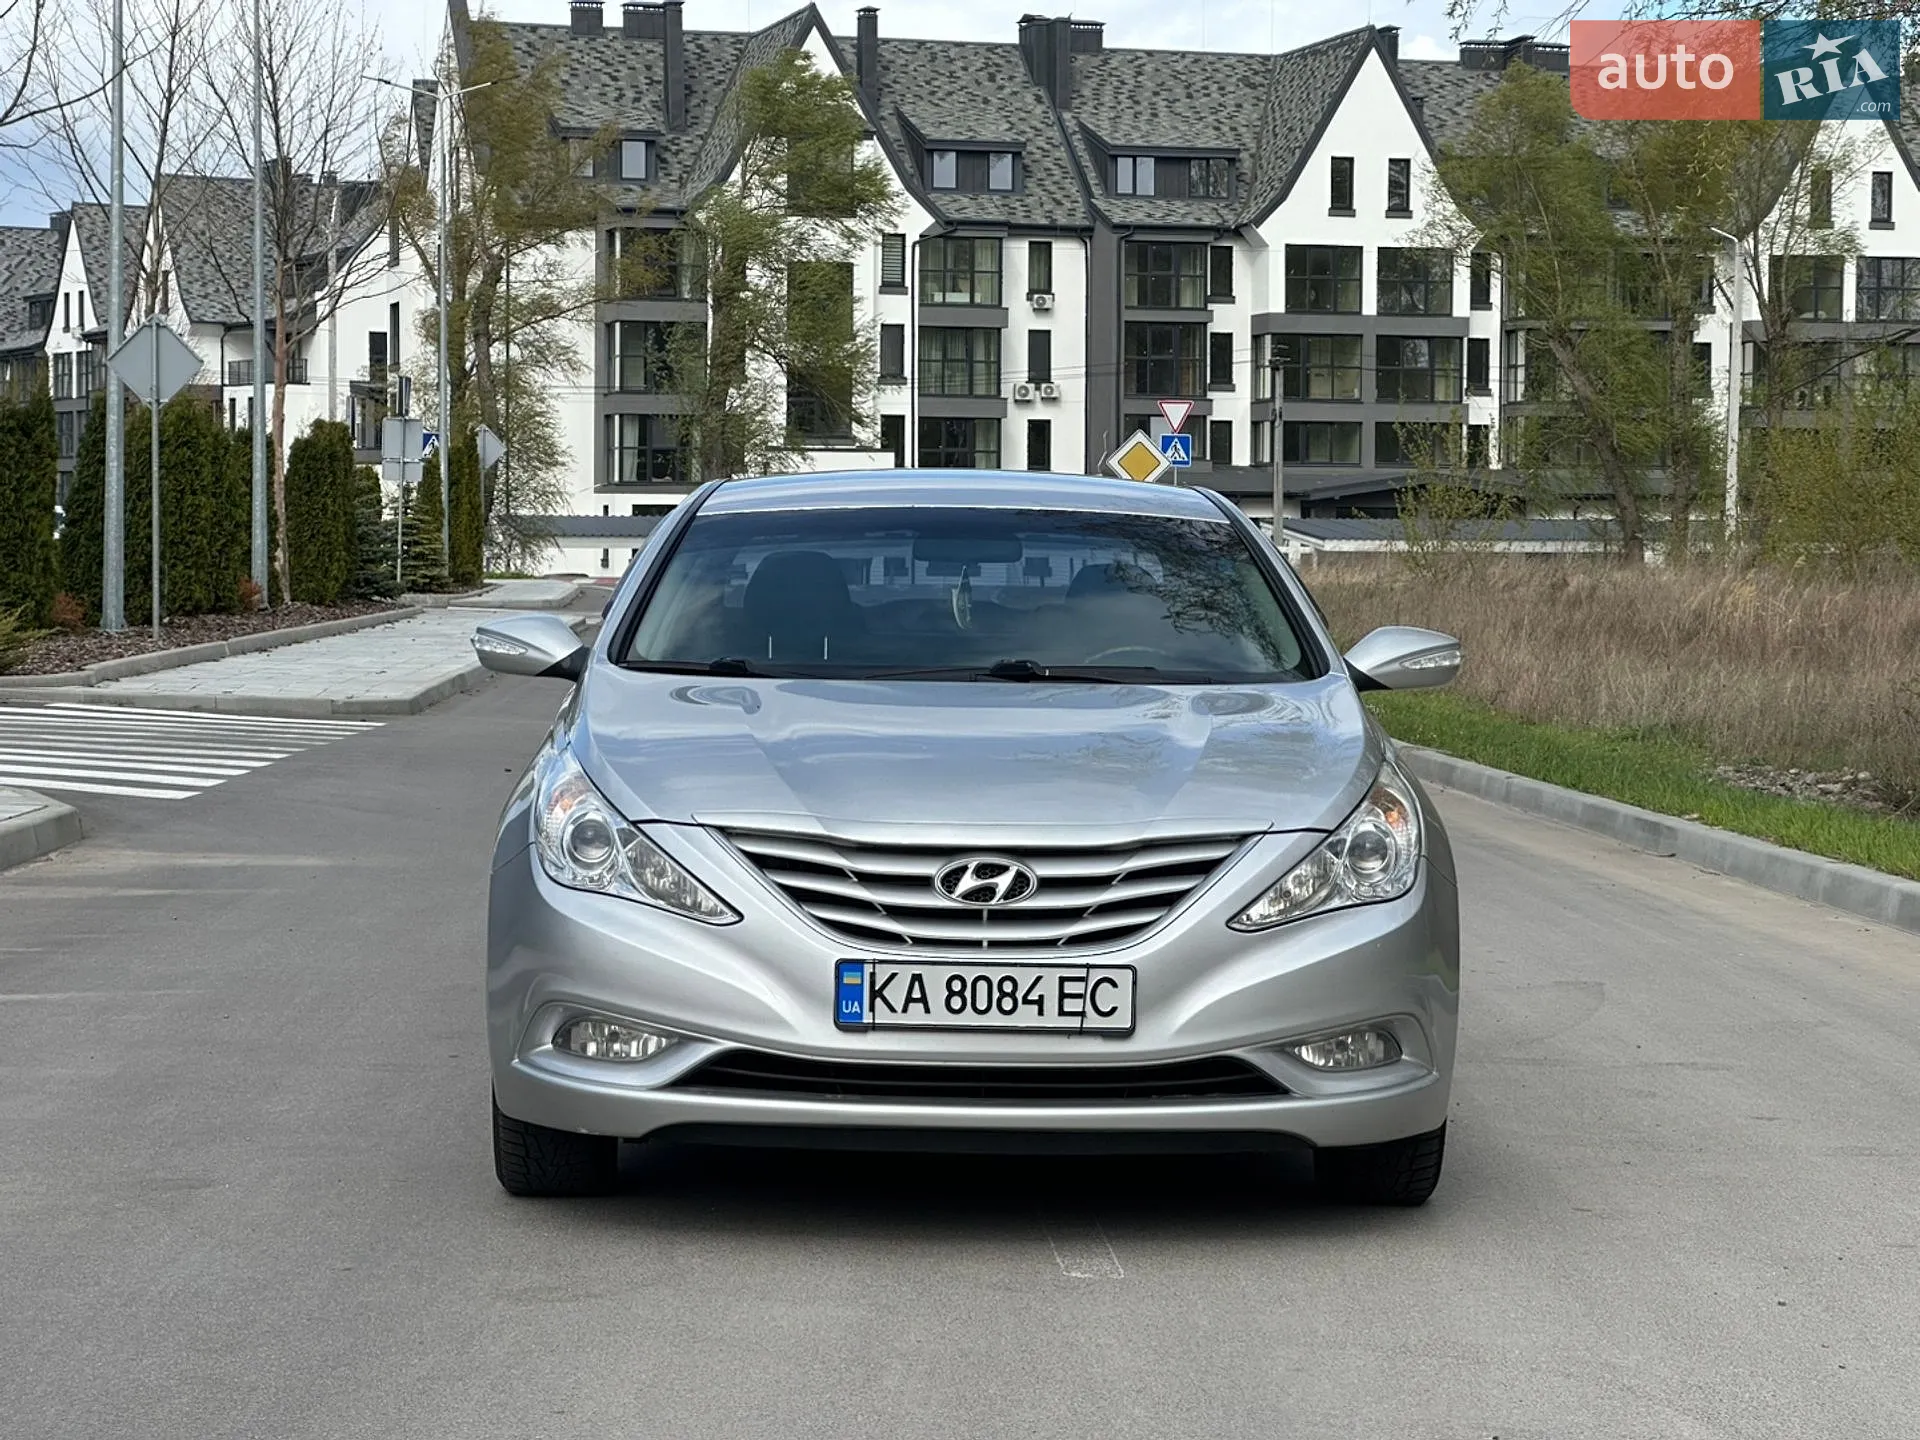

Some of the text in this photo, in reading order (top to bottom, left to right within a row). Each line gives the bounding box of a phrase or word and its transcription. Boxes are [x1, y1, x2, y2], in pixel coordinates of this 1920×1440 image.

[842, 1000, 861, 1014] UA
[868, 971, 1119, 1018] KA 8084 EC
